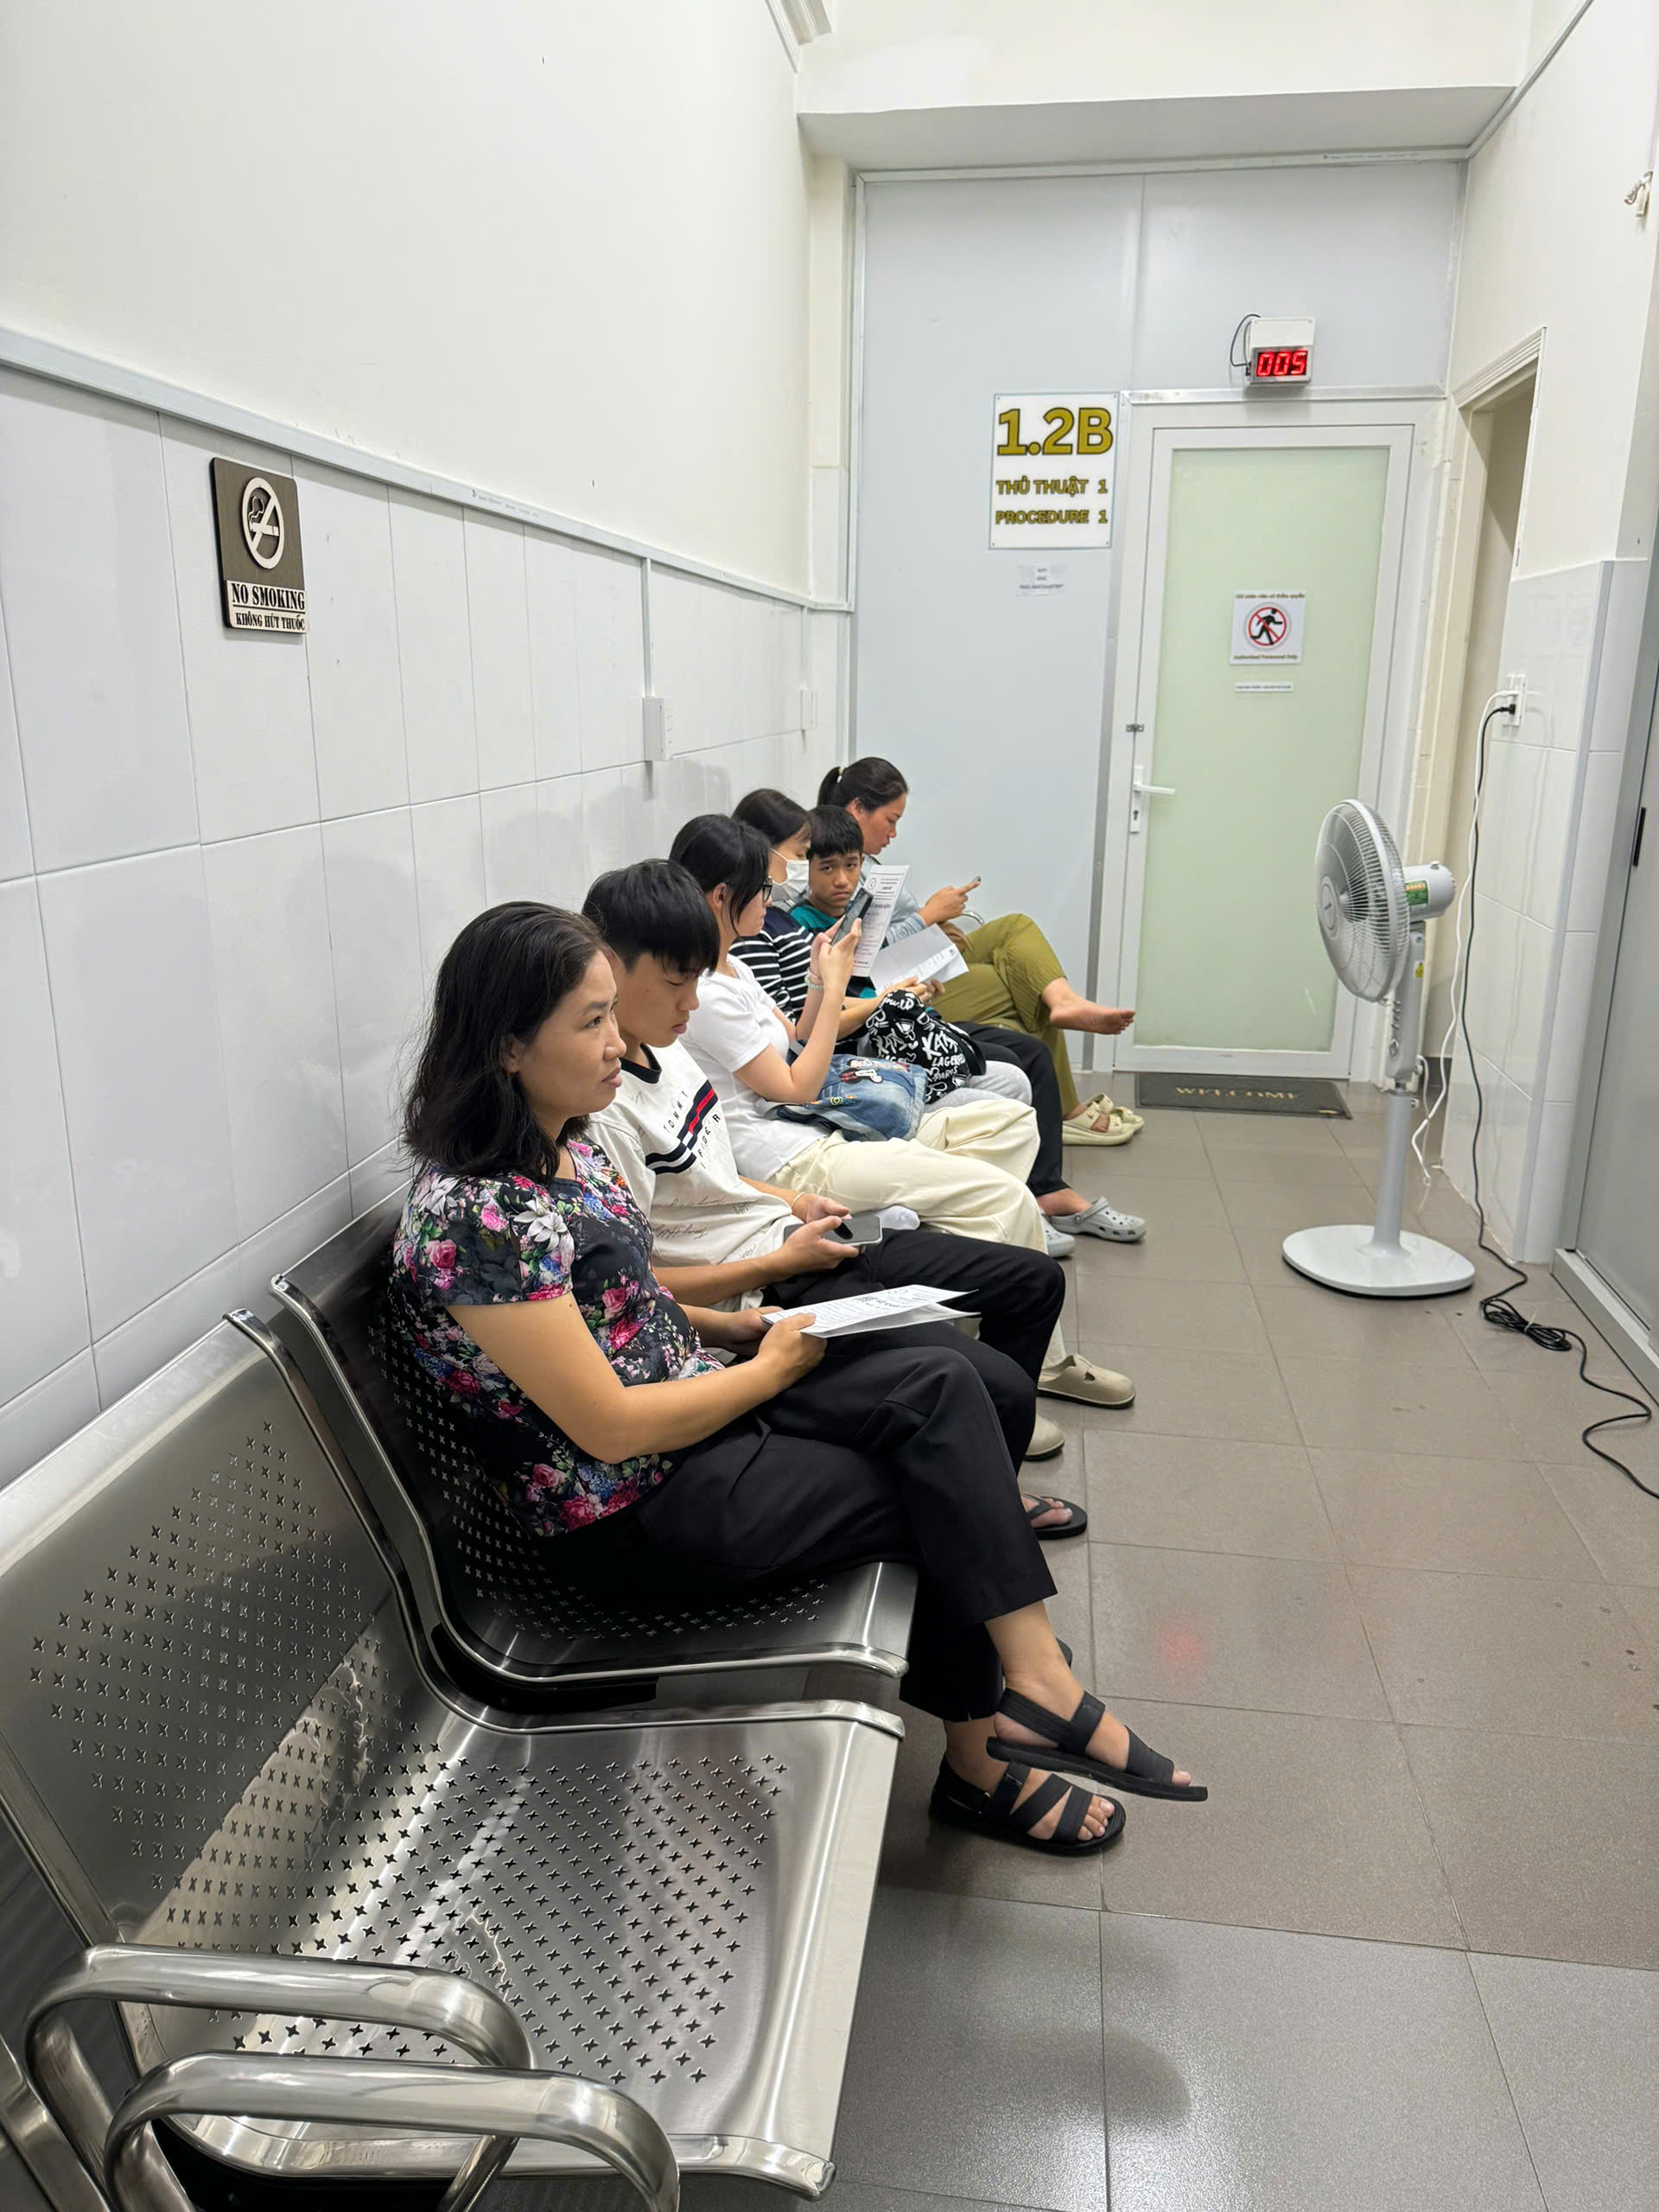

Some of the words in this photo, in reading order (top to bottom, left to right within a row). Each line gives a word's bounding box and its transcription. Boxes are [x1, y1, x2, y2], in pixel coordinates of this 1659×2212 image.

[1256, 352, 1306, 376] 005
[997, 407, 1113, 455] 1.2B
[995, 475, 1031, 495] THỦ
[1033, 476, 1089, 498] THUẬT
[1097, 479, 1108, 494] 1
[995, 509, 1090, 524] PROCEDURE
[1097, 509, 1108, 524] 1
[231, 582, 249, 604] NO
[251, 585, 305, 610] SMOKING
[235, 610, 263, 626] KHÔNG
[264, 613, 279, 628] HÚT
[281, 613, 305, 631] THUỐC
